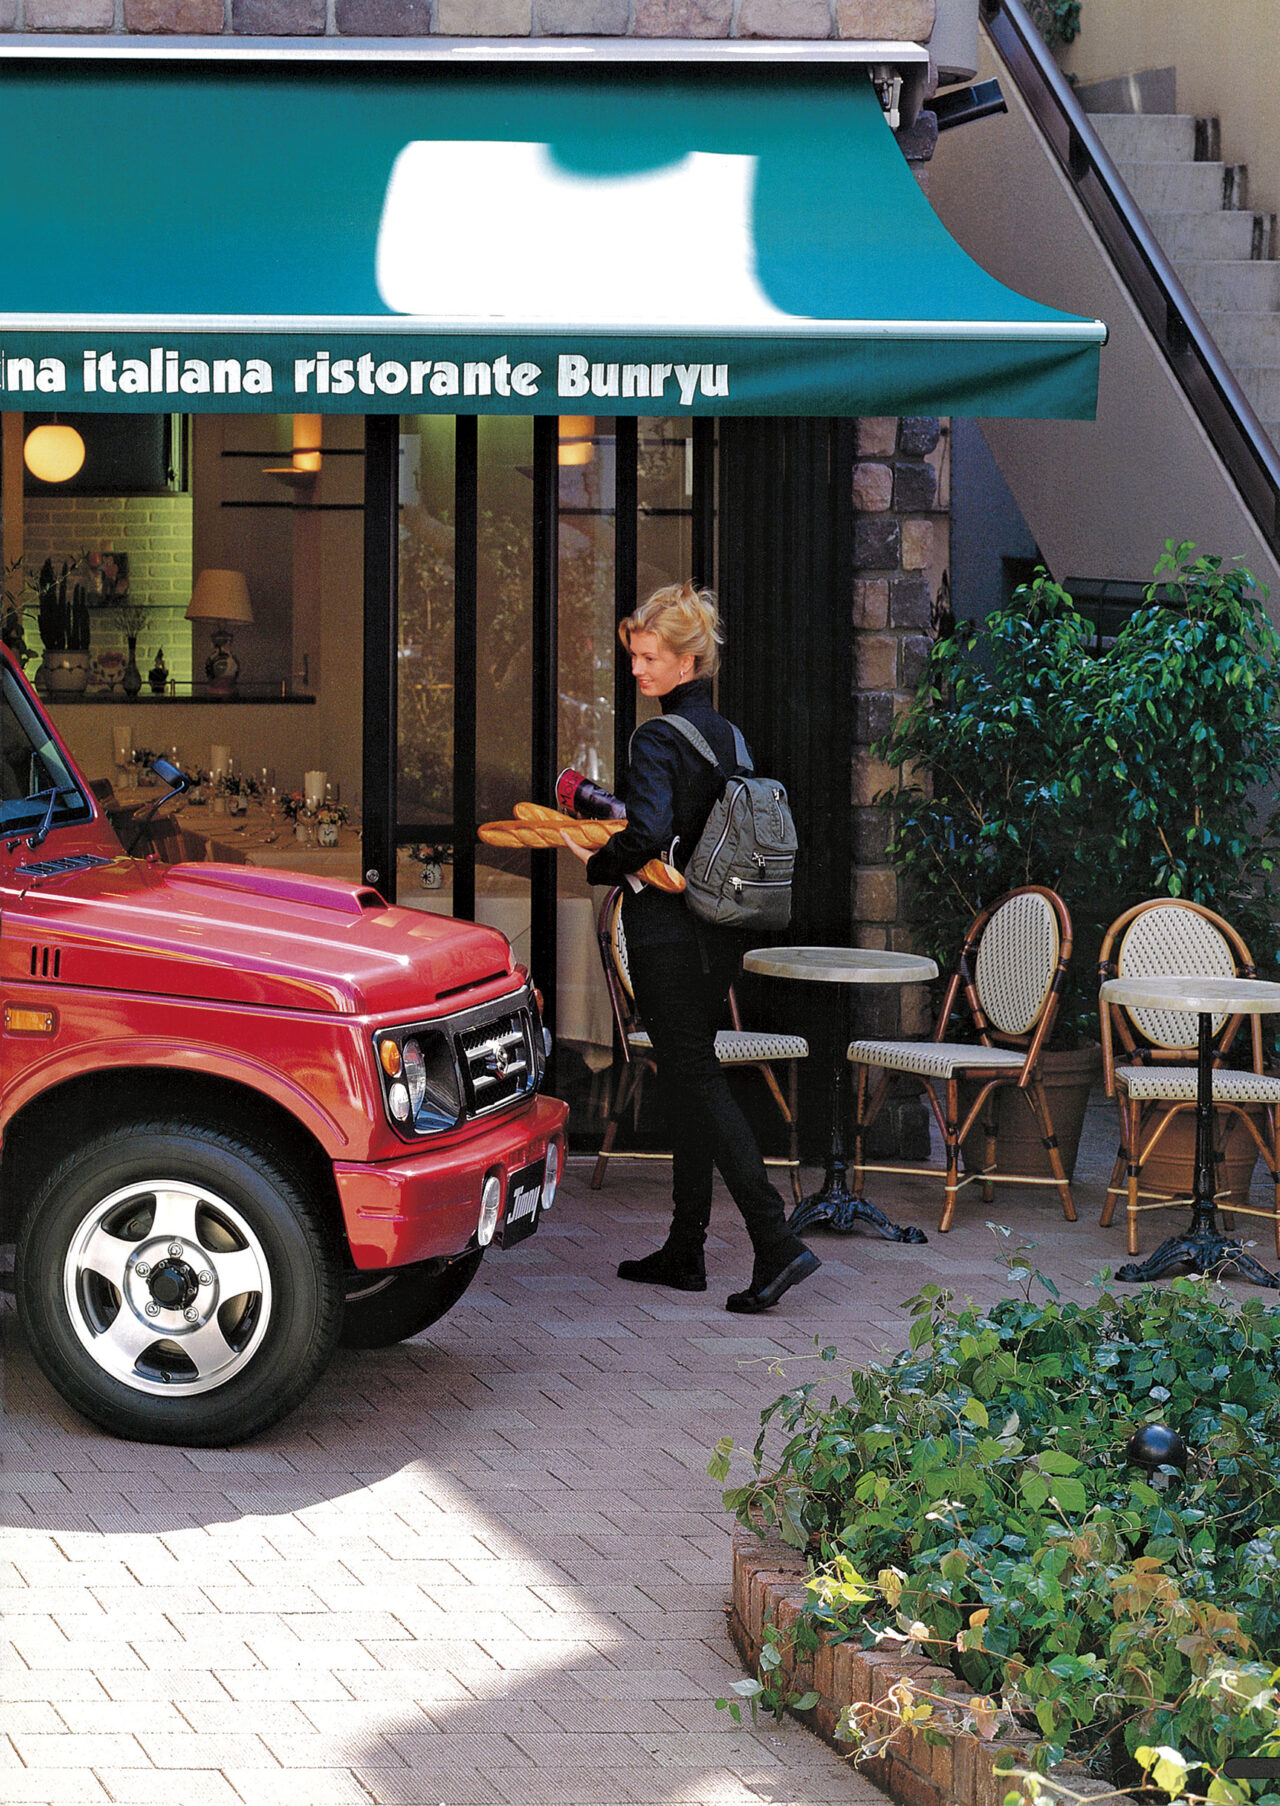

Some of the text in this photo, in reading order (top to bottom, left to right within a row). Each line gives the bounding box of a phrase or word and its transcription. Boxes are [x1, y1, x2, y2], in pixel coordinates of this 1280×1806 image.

[83, 347, 273, 394] italiana
[294, 351, 543, 397] ristorante
[557, 354, 730, 406] Bunryu
